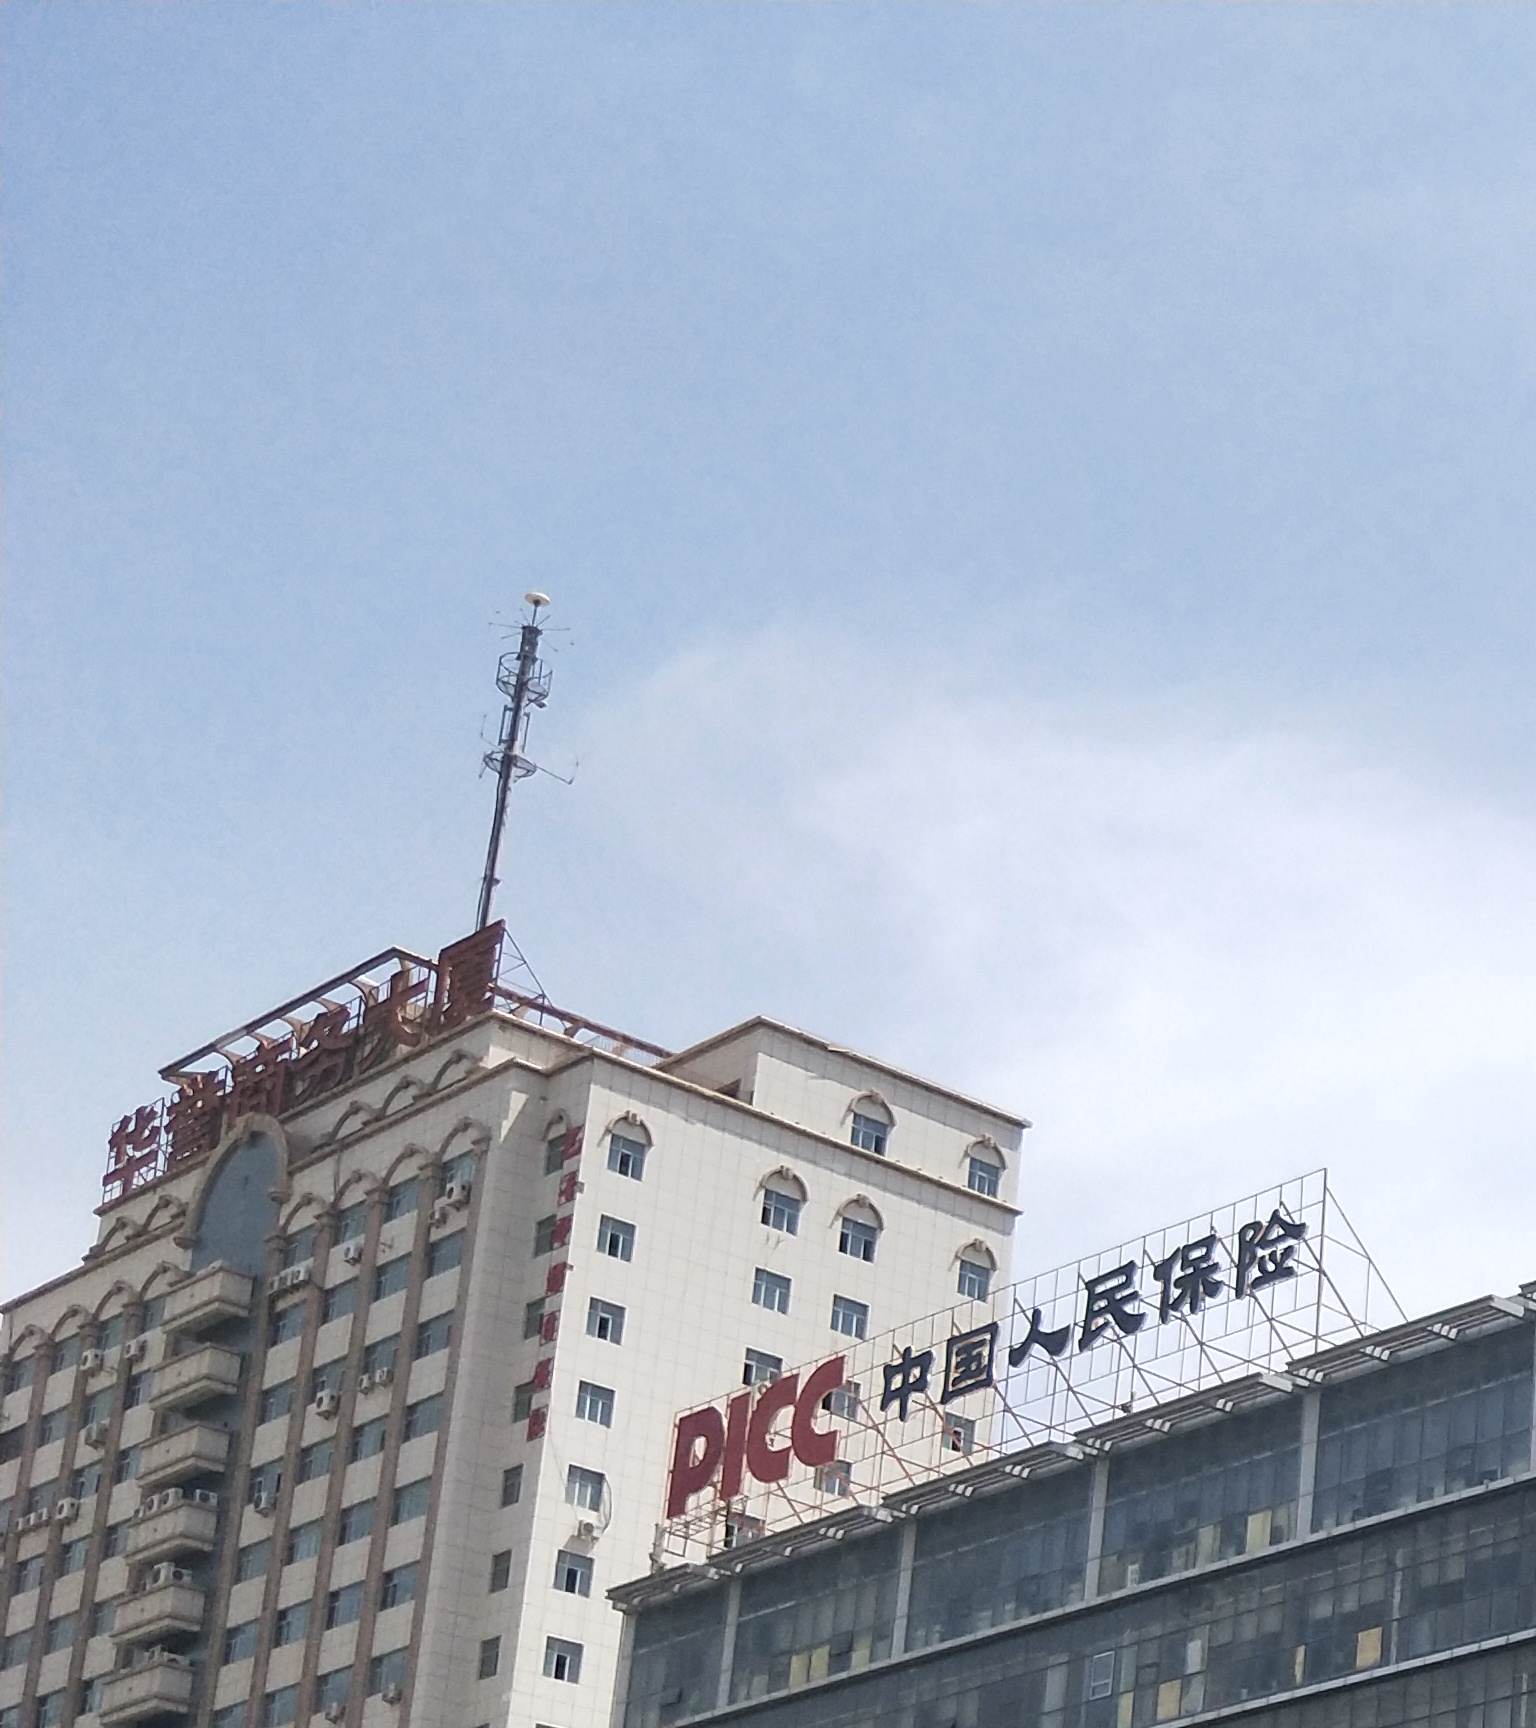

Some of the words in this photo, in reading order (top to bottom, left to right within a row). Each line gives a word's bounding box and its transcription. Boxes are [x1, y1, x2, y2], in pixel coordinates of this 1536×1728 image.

[667, 1355, 846, 1518] PICC
[881, 1208, 1308, 1422] 中国人民保险
